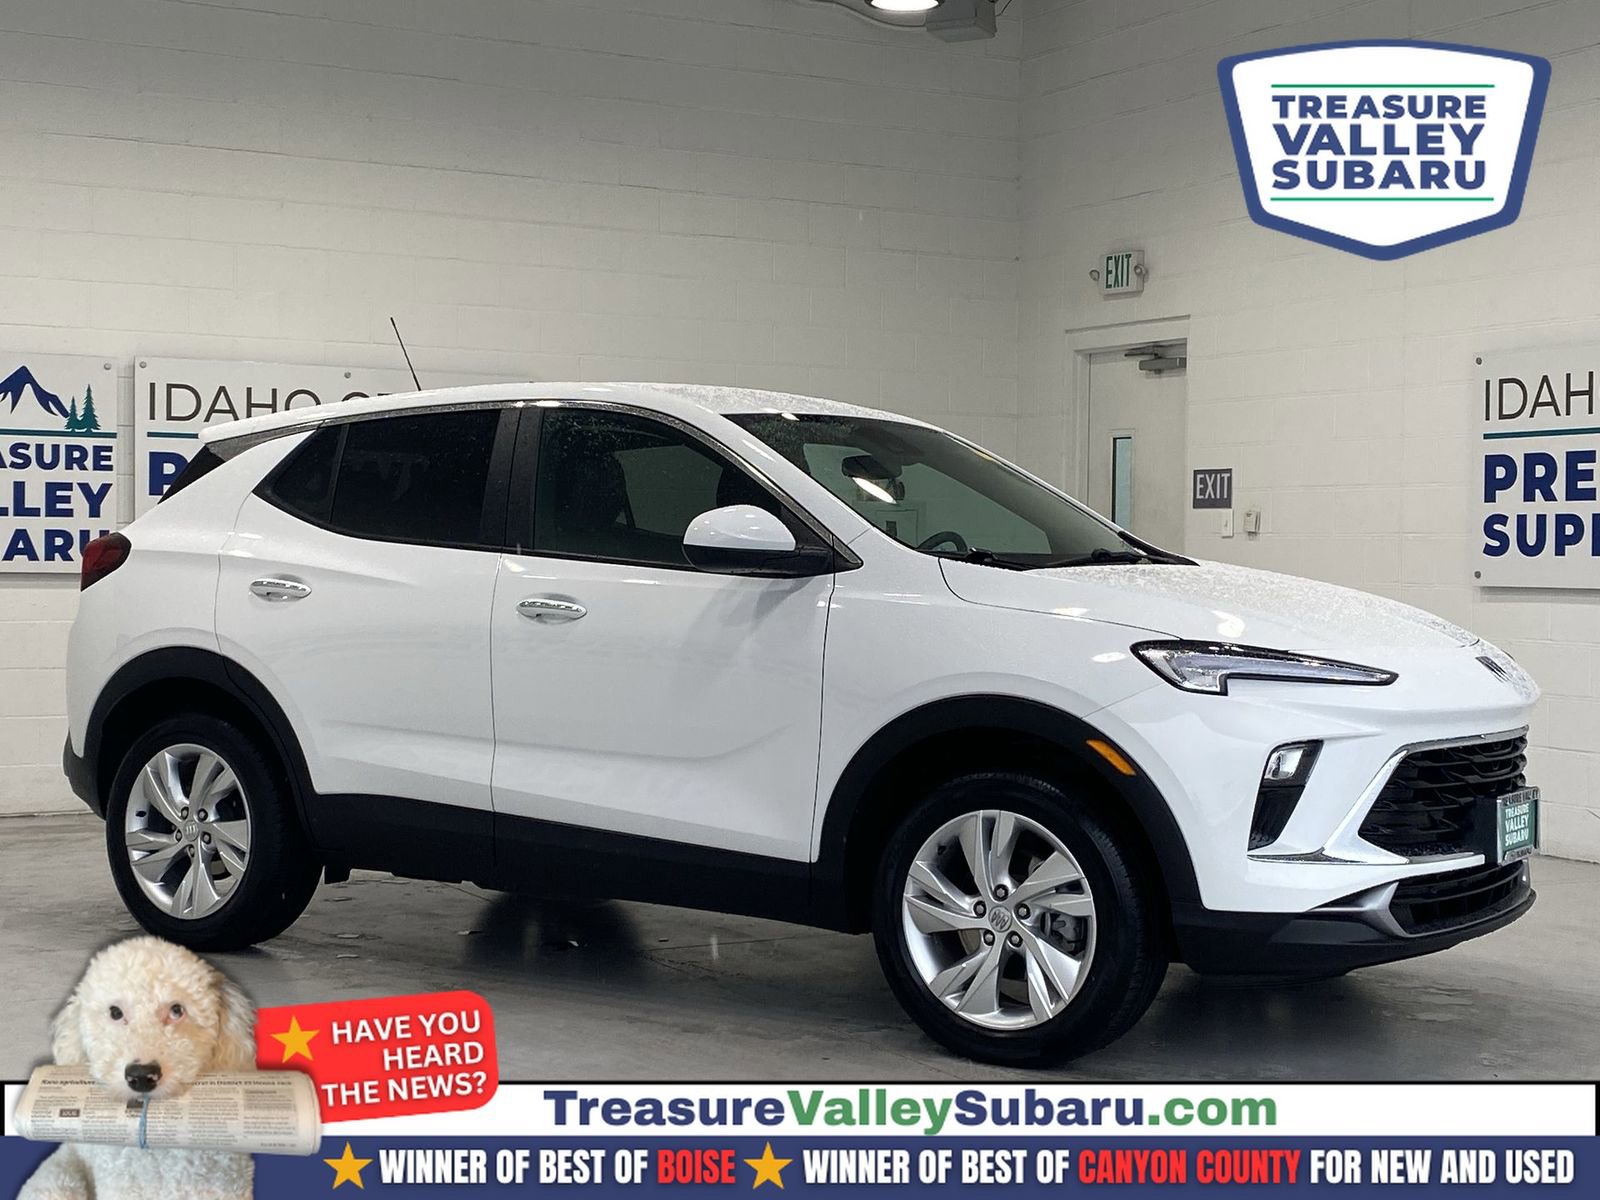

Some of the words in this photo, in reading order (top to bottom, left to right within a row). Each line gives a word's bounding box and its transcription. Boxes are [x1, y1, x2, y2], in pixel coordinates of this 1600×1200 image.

[1105, 253, 1132, 289] EXIT
[0, 442, 114, 472] SURE
[1196, 473, 1231, 499] EXIT
[1483, 450, 1597, 503] PRE
[1505, 814, 1529, 833] VALLEY
[1505, 828, 1529, 847] SUBARU
